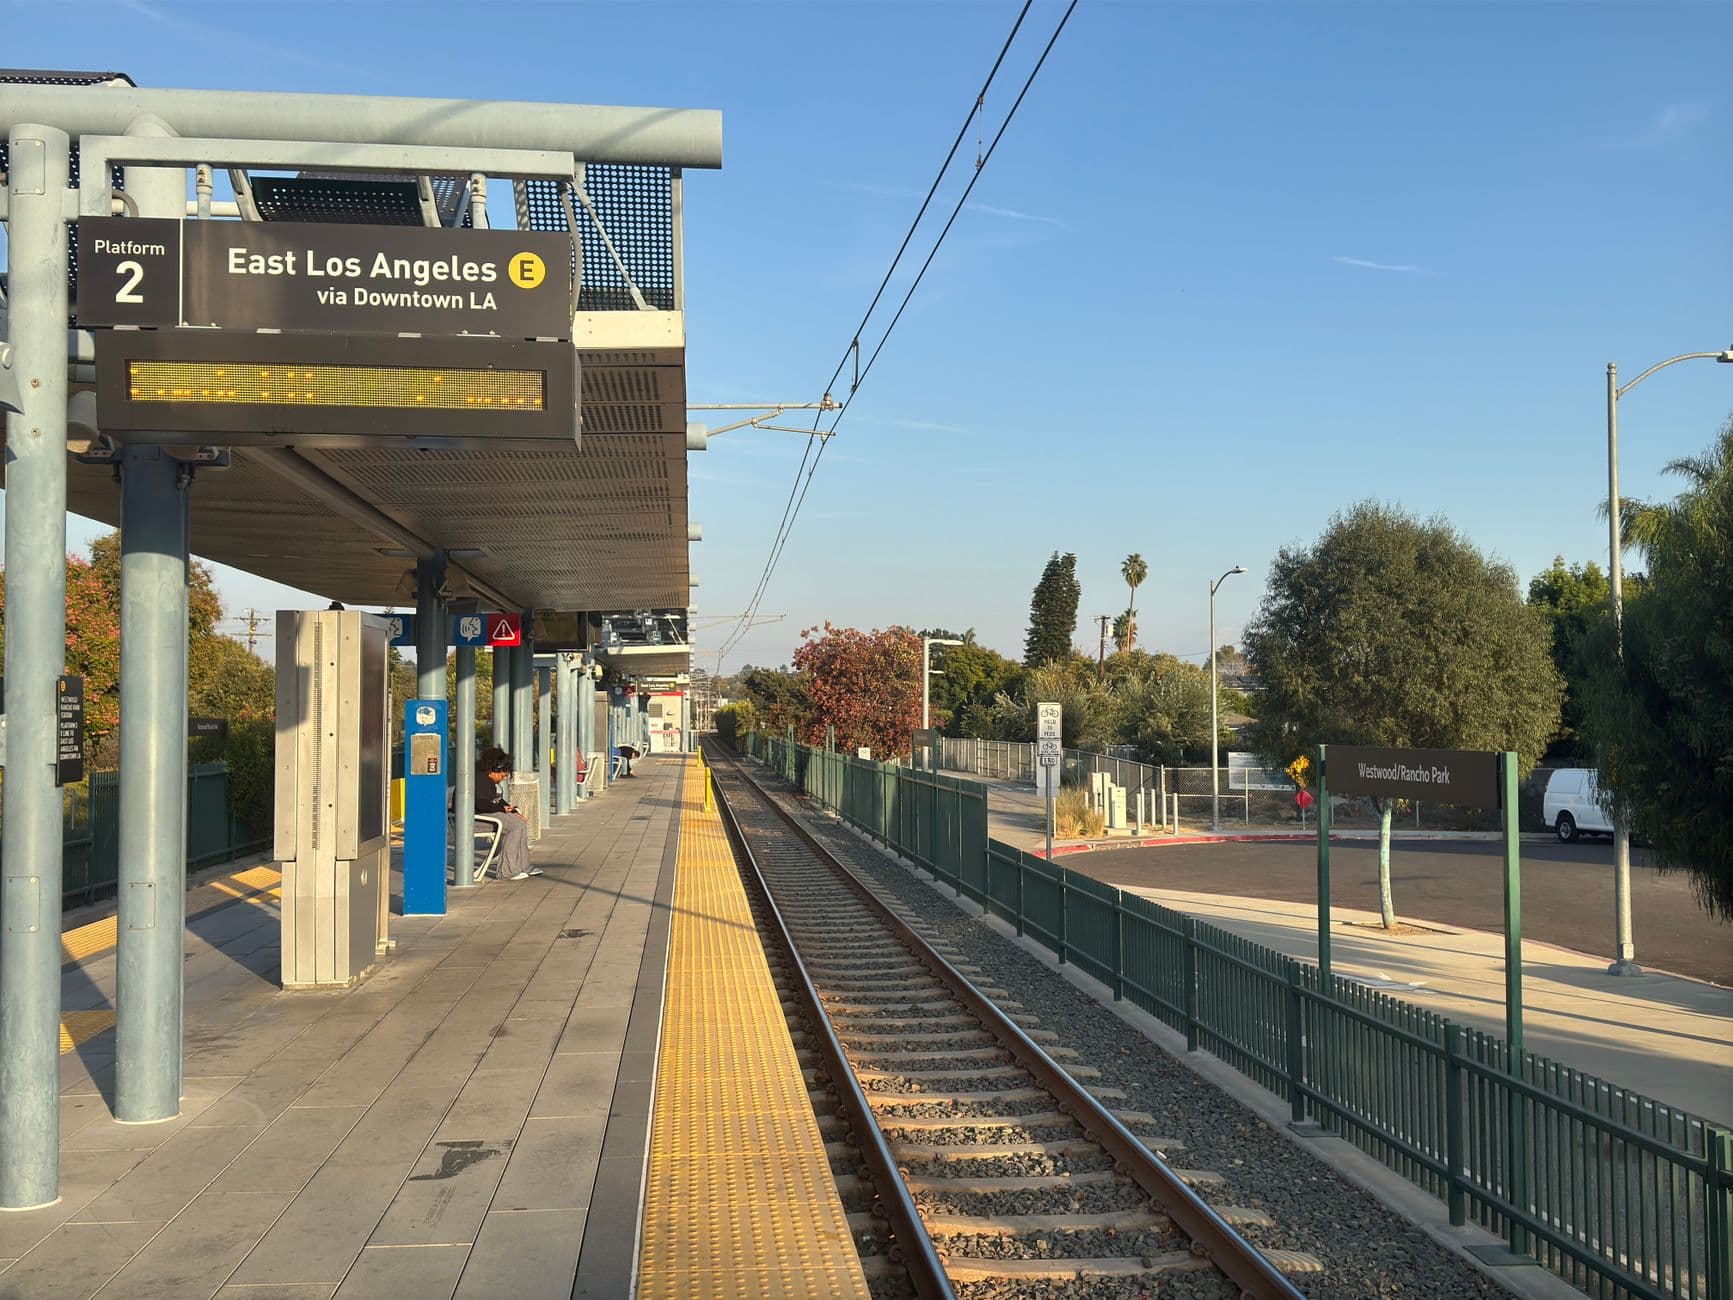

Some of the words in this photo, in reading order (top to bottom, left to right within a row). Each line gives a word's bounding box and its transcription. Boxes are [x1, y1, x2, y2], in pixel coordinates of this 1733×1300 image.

[94, 239, 165, 256] Platform
[228, 247, 296, 276] East
[306, 251, 360, 278] Los
[370, 252, 498, 286] Angeles
[519, 260, 534, 281] E
[115, 261, 143, 304] 2
[316, 287, 347, 305] via
[354, 287, 464, 310] Downtown
[469, 291, 497, 311] LA
[1044, 757, 1055, 765] END
[1358, 763, 1430, 783] Westwood/Rancho
[1431, 766, 1450, 784] Park
